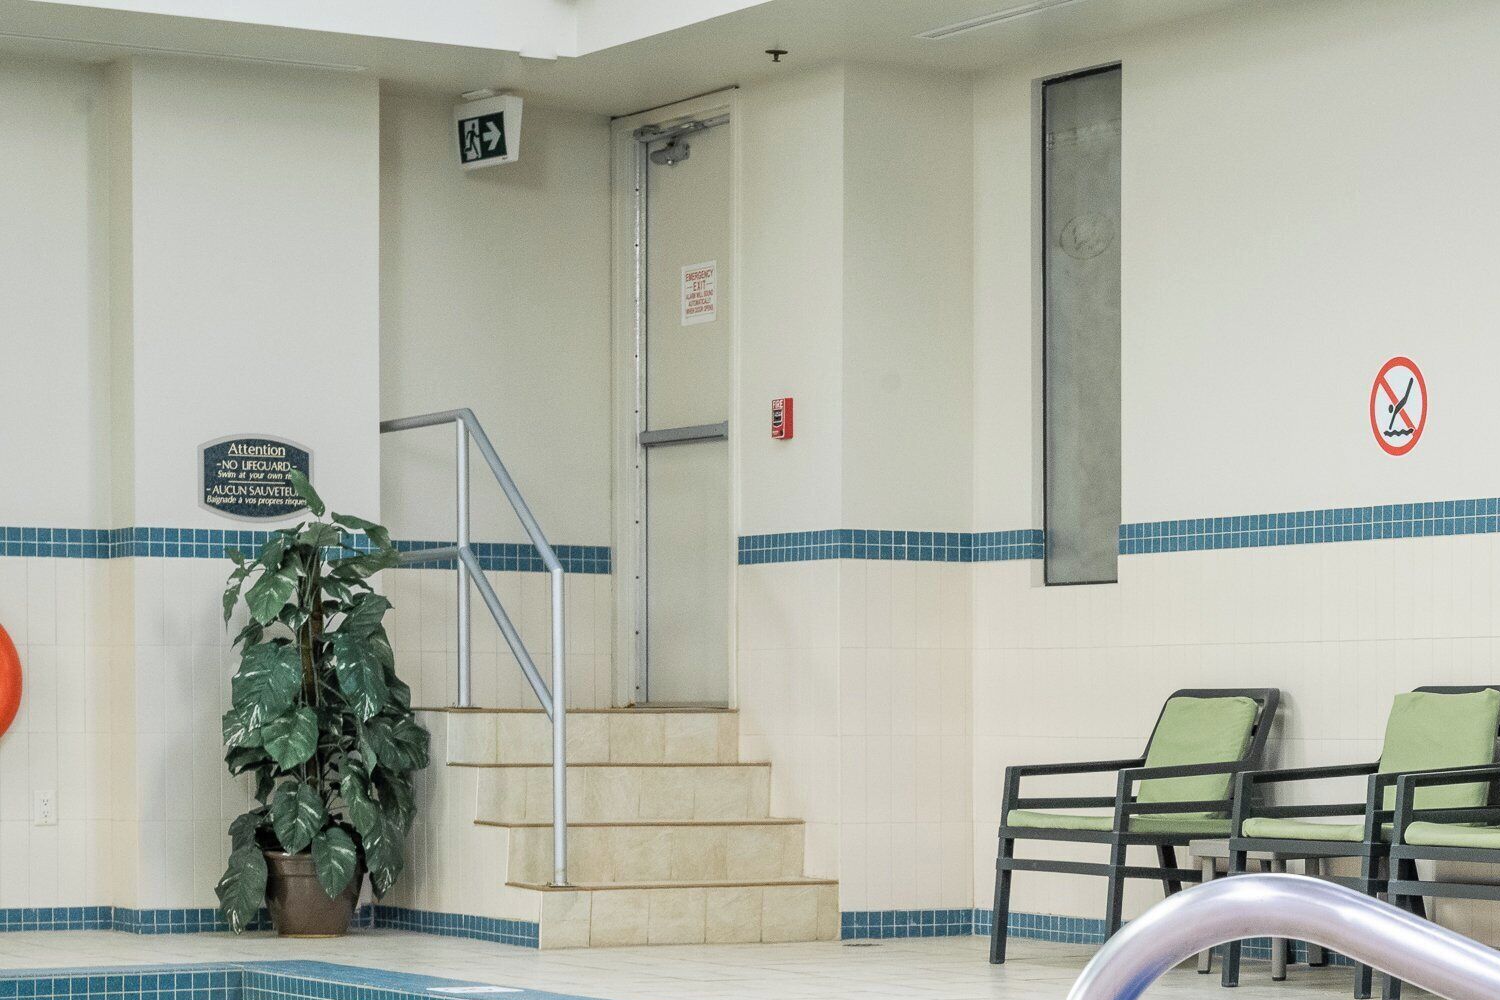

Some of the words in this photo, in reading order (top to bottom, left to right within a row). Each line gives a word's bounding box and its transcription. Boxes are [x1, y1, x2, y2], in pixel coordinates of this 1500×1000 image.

[685, 269, 713, 282] EMERGENCY
[693, 280, 706, 291] EXIT
[228, 443, 285, 457] Attention
[217, 470, 236, 478] Swim
[249, 472, 265, 480] your
[249, 486, 298, 496] SAUVETEU
[206, 495, 237, 504] Baignade
[258, 498, 283, 506] propres
